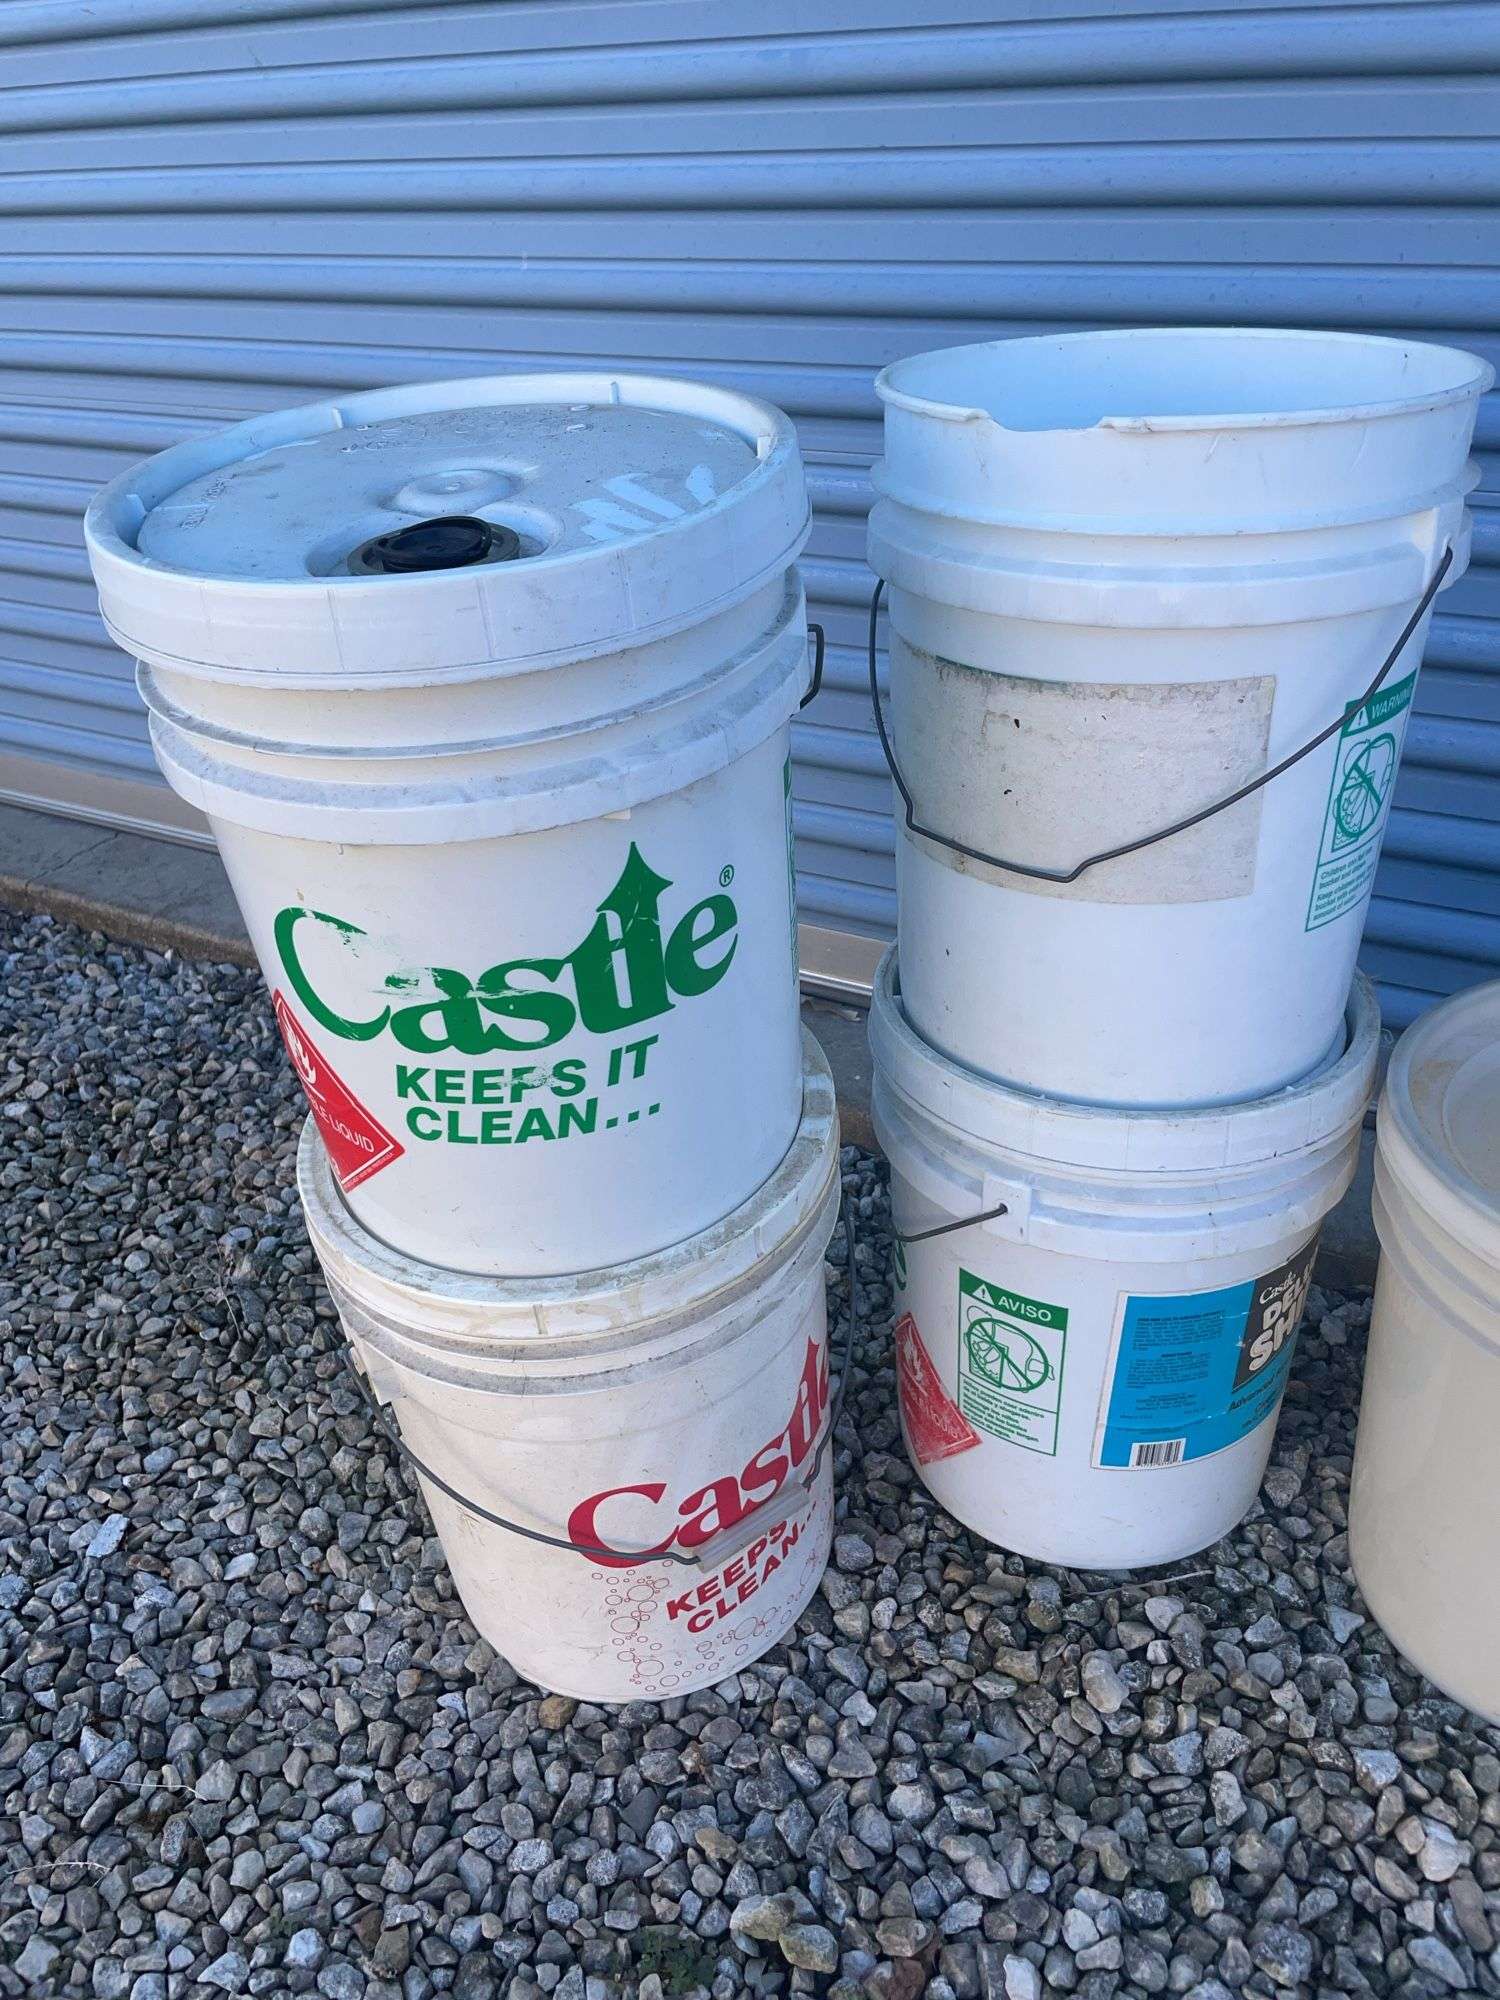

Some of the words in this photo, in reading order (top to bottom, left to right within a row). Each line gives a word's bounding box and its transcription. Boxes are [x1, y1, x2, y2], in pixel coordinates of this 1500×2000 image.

[274, 841, 738, 1055] Castle
[395, 1058, 587, 1105] KEEPS
[606, 1034, 660, 1087] IT
[997, 1295, 1052, 1323] AVISO
